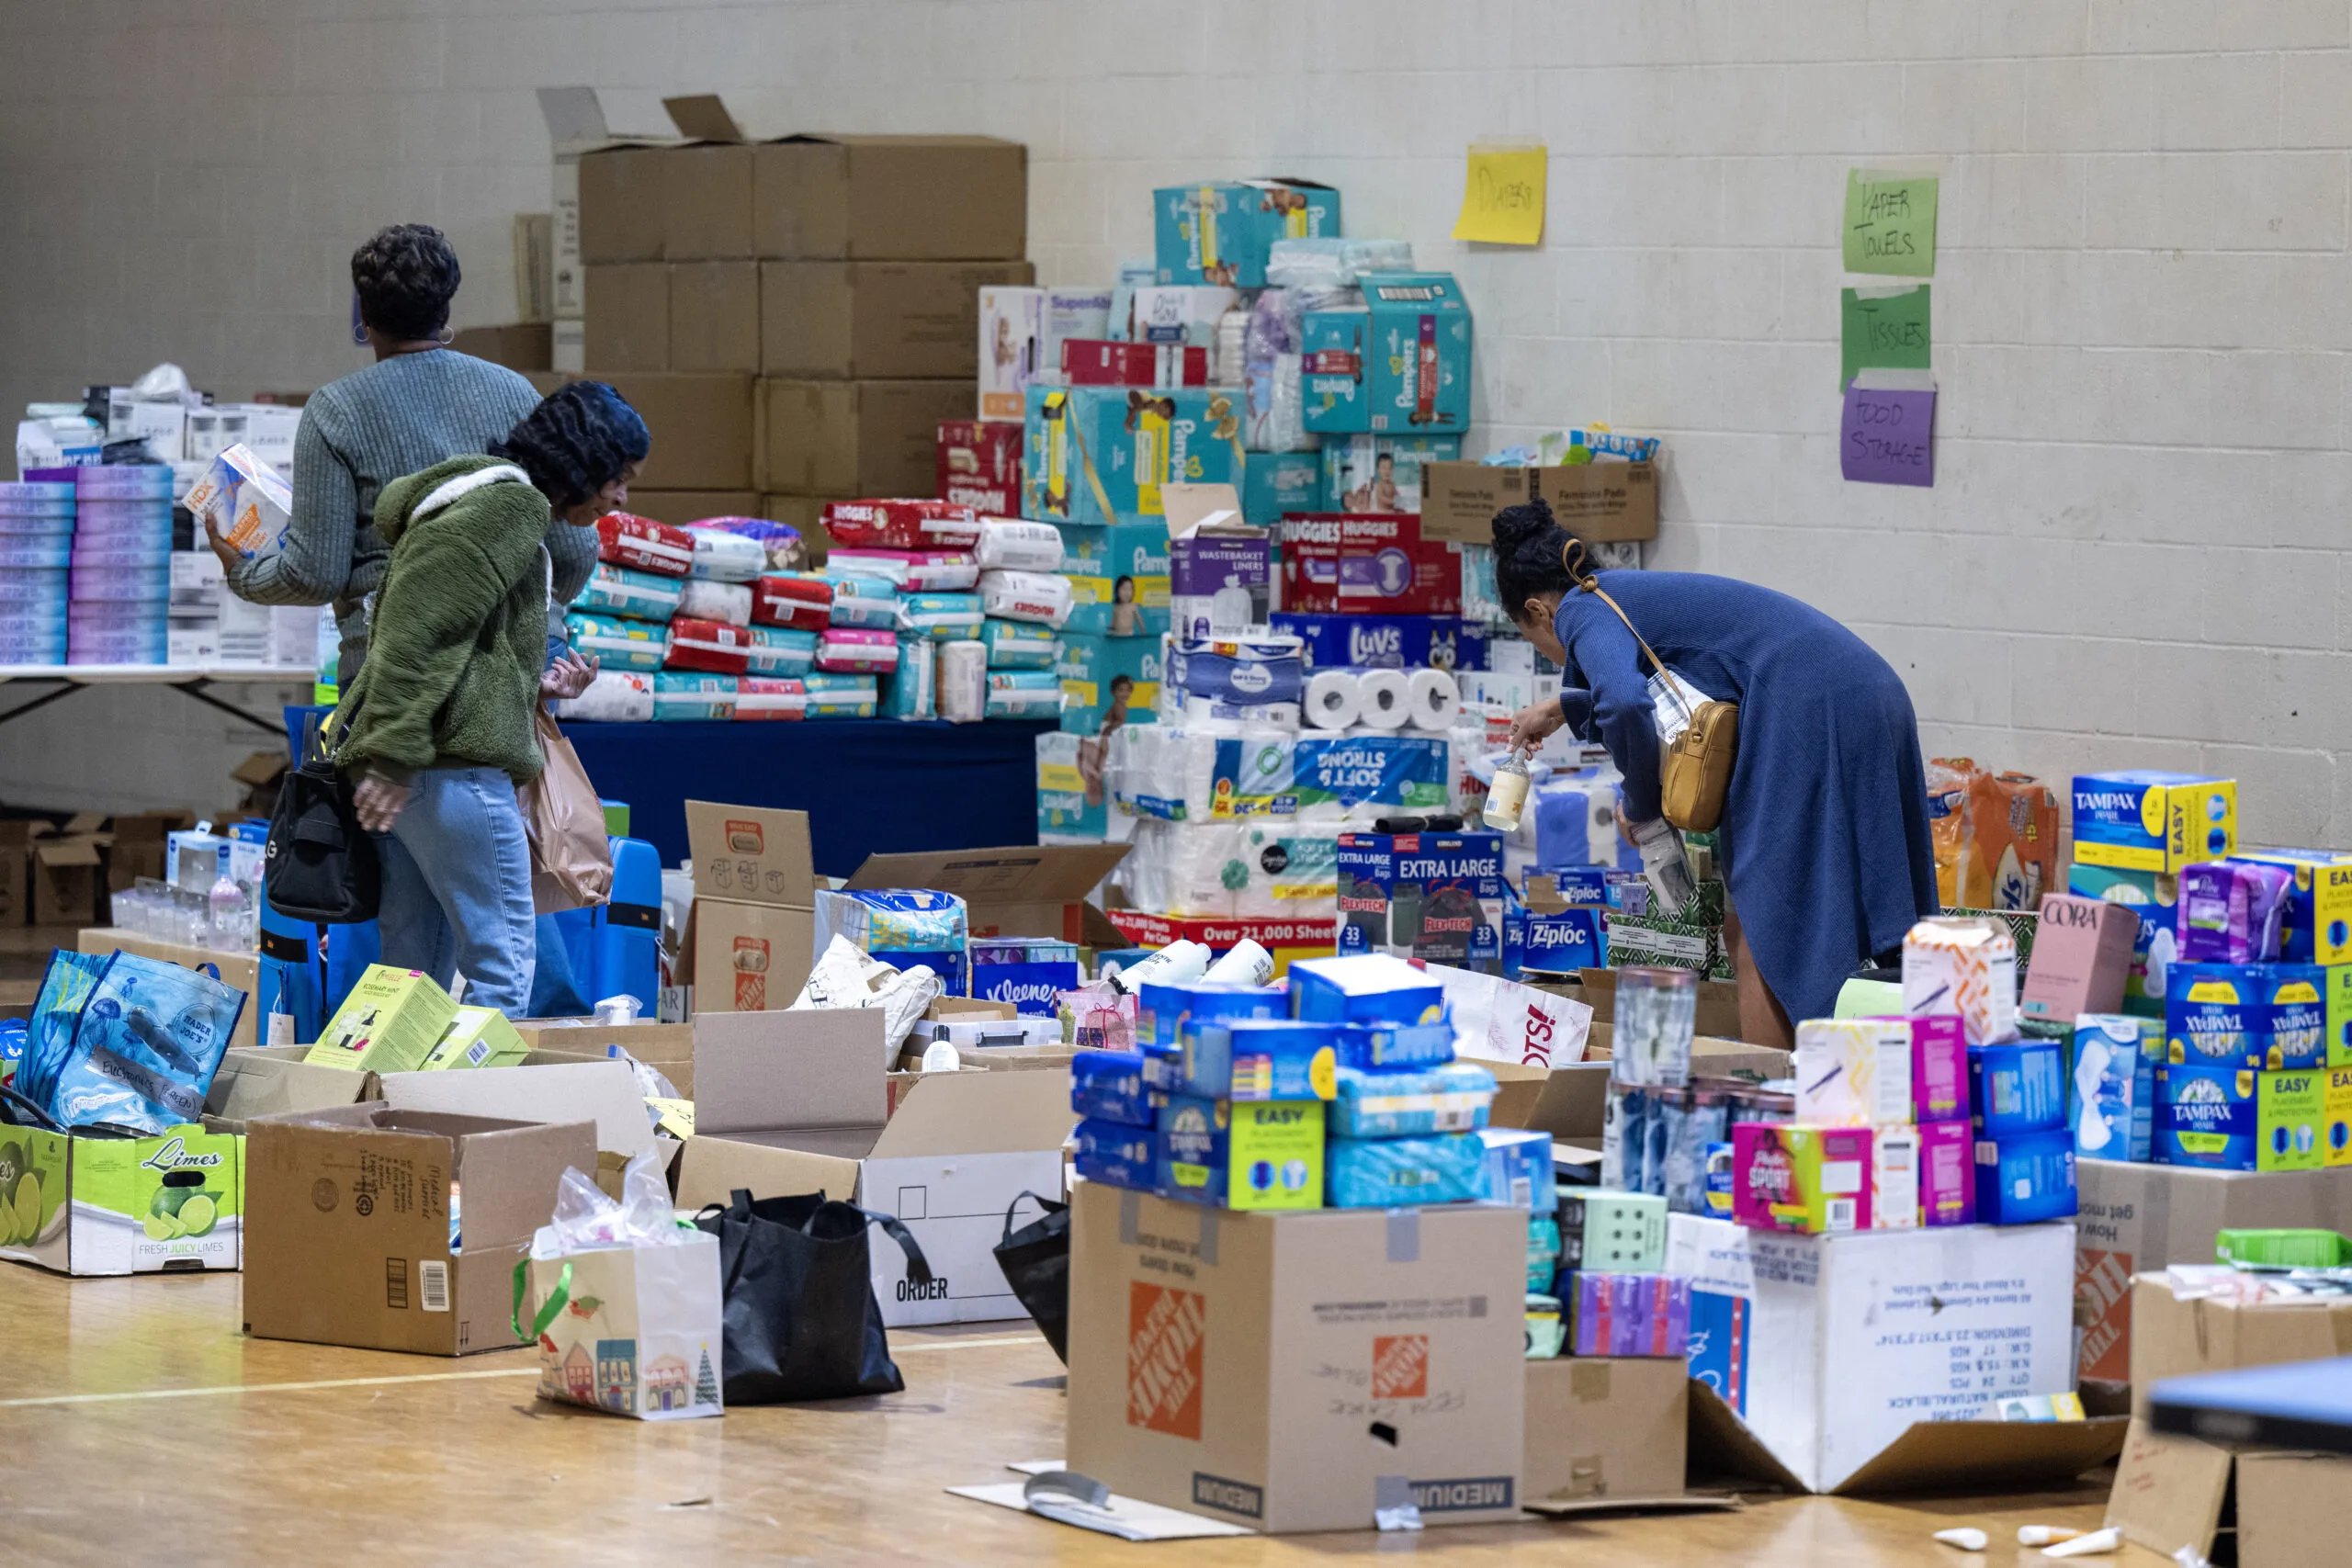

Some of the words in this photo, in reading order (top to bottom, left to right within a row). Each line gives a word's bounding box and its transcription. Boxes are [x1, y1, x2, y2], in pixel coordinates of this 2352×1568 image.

[1861, 184, 1911, 221] PAPER
[1858, 306, 1926, 352] TISSUES
[1396, 338, 1417, 407] Pampers
[187, 480, 215, 510] HDX
[1282, 520, 1340, 543] HUGGIES
[1342, 521, 1398, 537] HUGGIES
[1198, 551, 1264, 561] WASTEBASKET
[1232, 561, 1264, 571] LINERS
[1317, 751, 1385, 769] STRONG
[1319, 769, 1332, 787] &
[1340, 771, 1381, 787] SOFT
[2074, 793, 2137, 810] TAMPAX
[2173, 805, 2184, 855] EASY
[1339, 852, 1363, 863] EXTRA
[1364, 853, 1391, 865] LARGE
[1374, 868, 1391, 879] Bags
[1400, 860, 1448, 879] EXTRA
[1452, 859, 1497, 876] LARGE
[2330, 871, 2352, 886] EAS
[1479, 881, 1499, 896] Bags
[1567, 886, 1601, 902] Ziploc
[2044, 900, 2098, 931] CORA
[1204, 926, 1238, 942] Over
[1241, 925, 1292, 942] 21,000
[1295, 923, 1338, 940] Sheet
[1346, 927, 1360, 942] 33
[1476, 927, 1491, 942] 33
[1532, 922, 1586, 949] Ziploc
[184, 1015, 211, 1036] TRADER
[2186, 1014, 2245, 1032] TAMPAX
[2272, 1011, 2322, 1031] TAMPAX
[180, 1028, 203, 1043] JOE'S
[2275, 1077, 2312, 1093] EASY
[2332, 1074, 2352, 1088] EAS
[1254, 1109, 1305, 1125] EASY
[2173, 1104, 2233, 1121] TAMPAX
[141, 1136, 223, 1171] Limes
[1749, 1168, 1790, 1189] SPORT
[2110, 1203, 2134, 1220] get
[2086, 1225, 2118, 1242] How
[140, 1245, 168, 1255] FRESH
[169, 1244, 196, 1255] JUICY
[198, 1242, 223, 1253] LIMES
[896, 1278, 948, 1303] ORDER
[1197, 1480, 1259, 1514] MEDIUM
